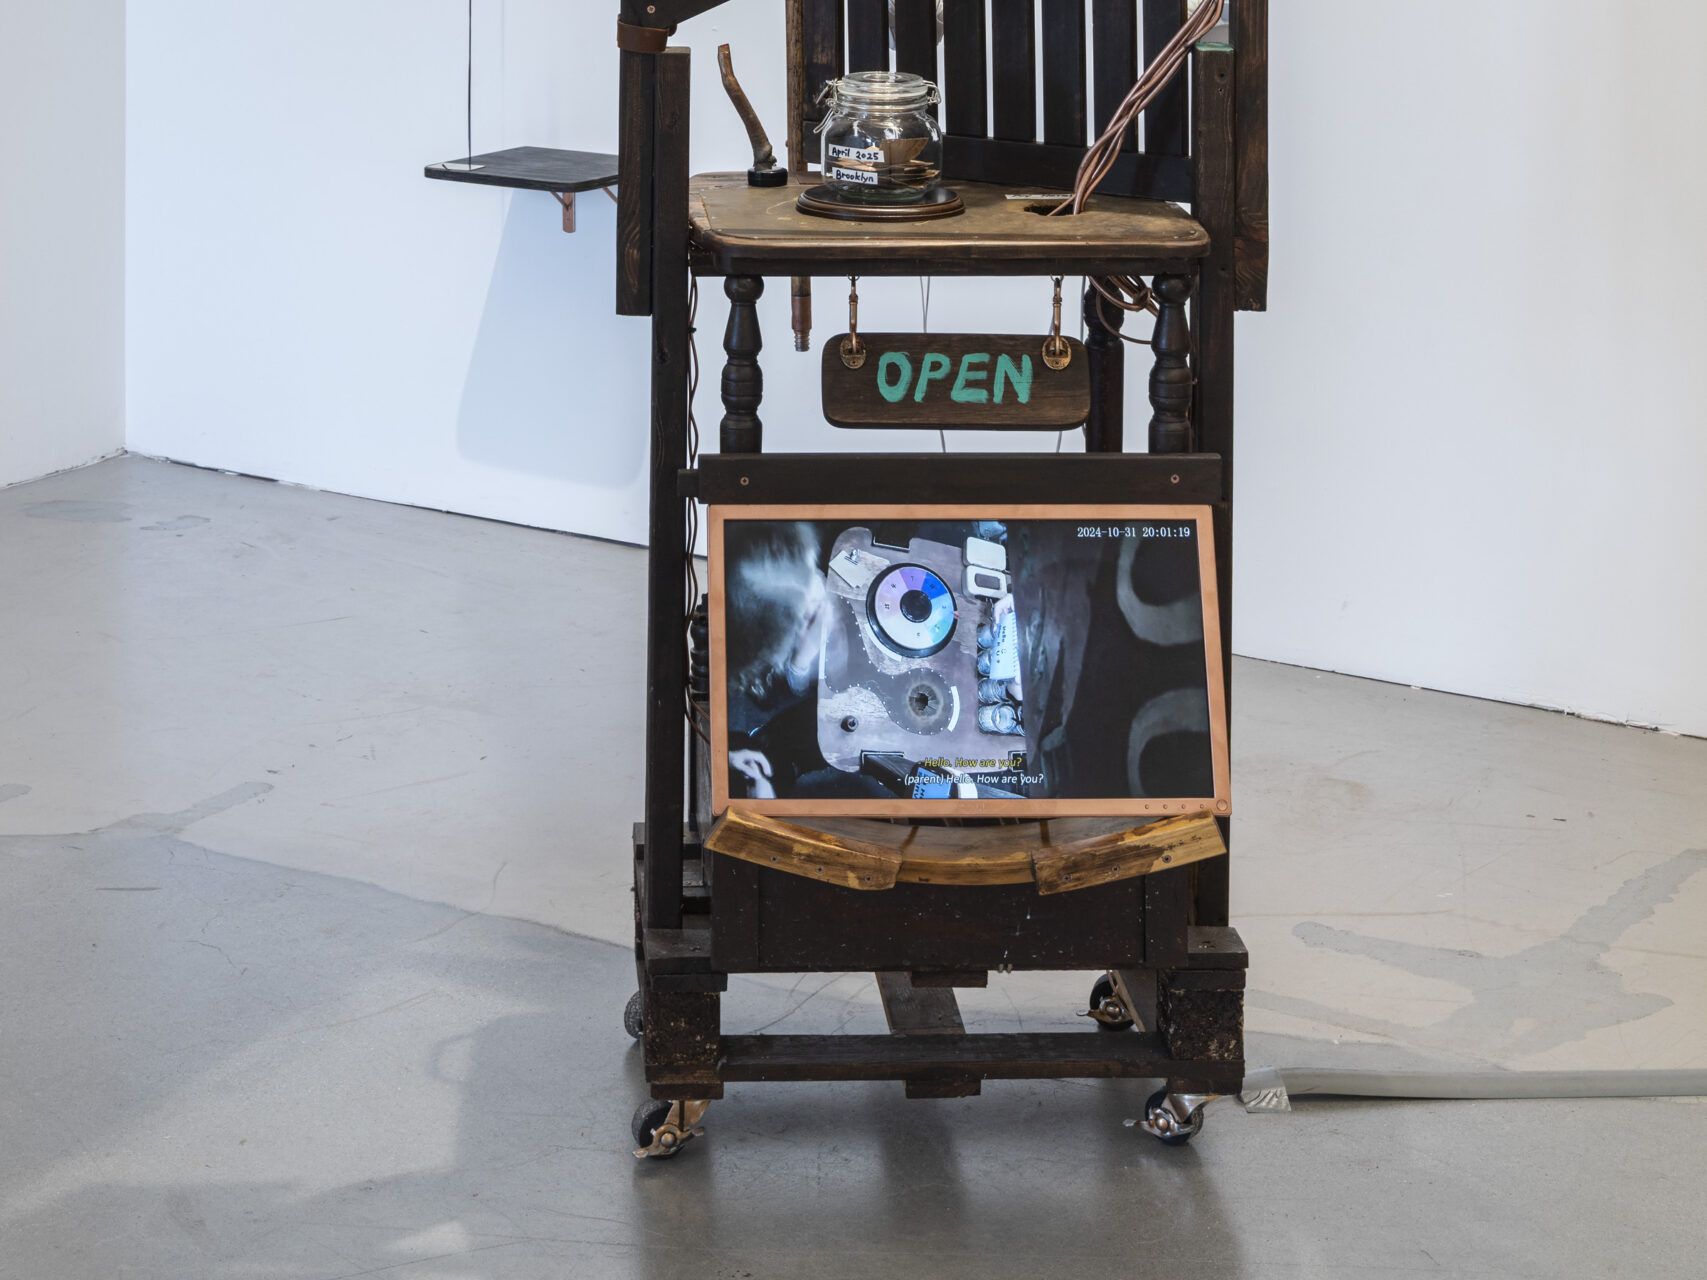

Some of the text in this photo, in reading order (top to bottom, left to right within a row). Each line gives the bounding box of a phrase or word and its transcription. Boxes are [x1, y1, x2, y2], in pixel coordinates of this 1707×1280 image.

[831, 147, 879, 160] April 2025
[835, 169, 874, 183] Brooklyn
[876, 351, 1034, 404] OPEN
[1077, 526, 1191, 538] 2024-10-31 20:01:19
[924, 757, 953, 768] Hello.
[955, 757, 978, 768] How
[979, 759, 996, 768] are
[999, 757, 1023, 769] you?
[904, 773, 944, 786] (parent)
[977, 774, 999, 784] How
[1001, 775, 1018, 784] are
[1020, 773, 1044, 786] you?
